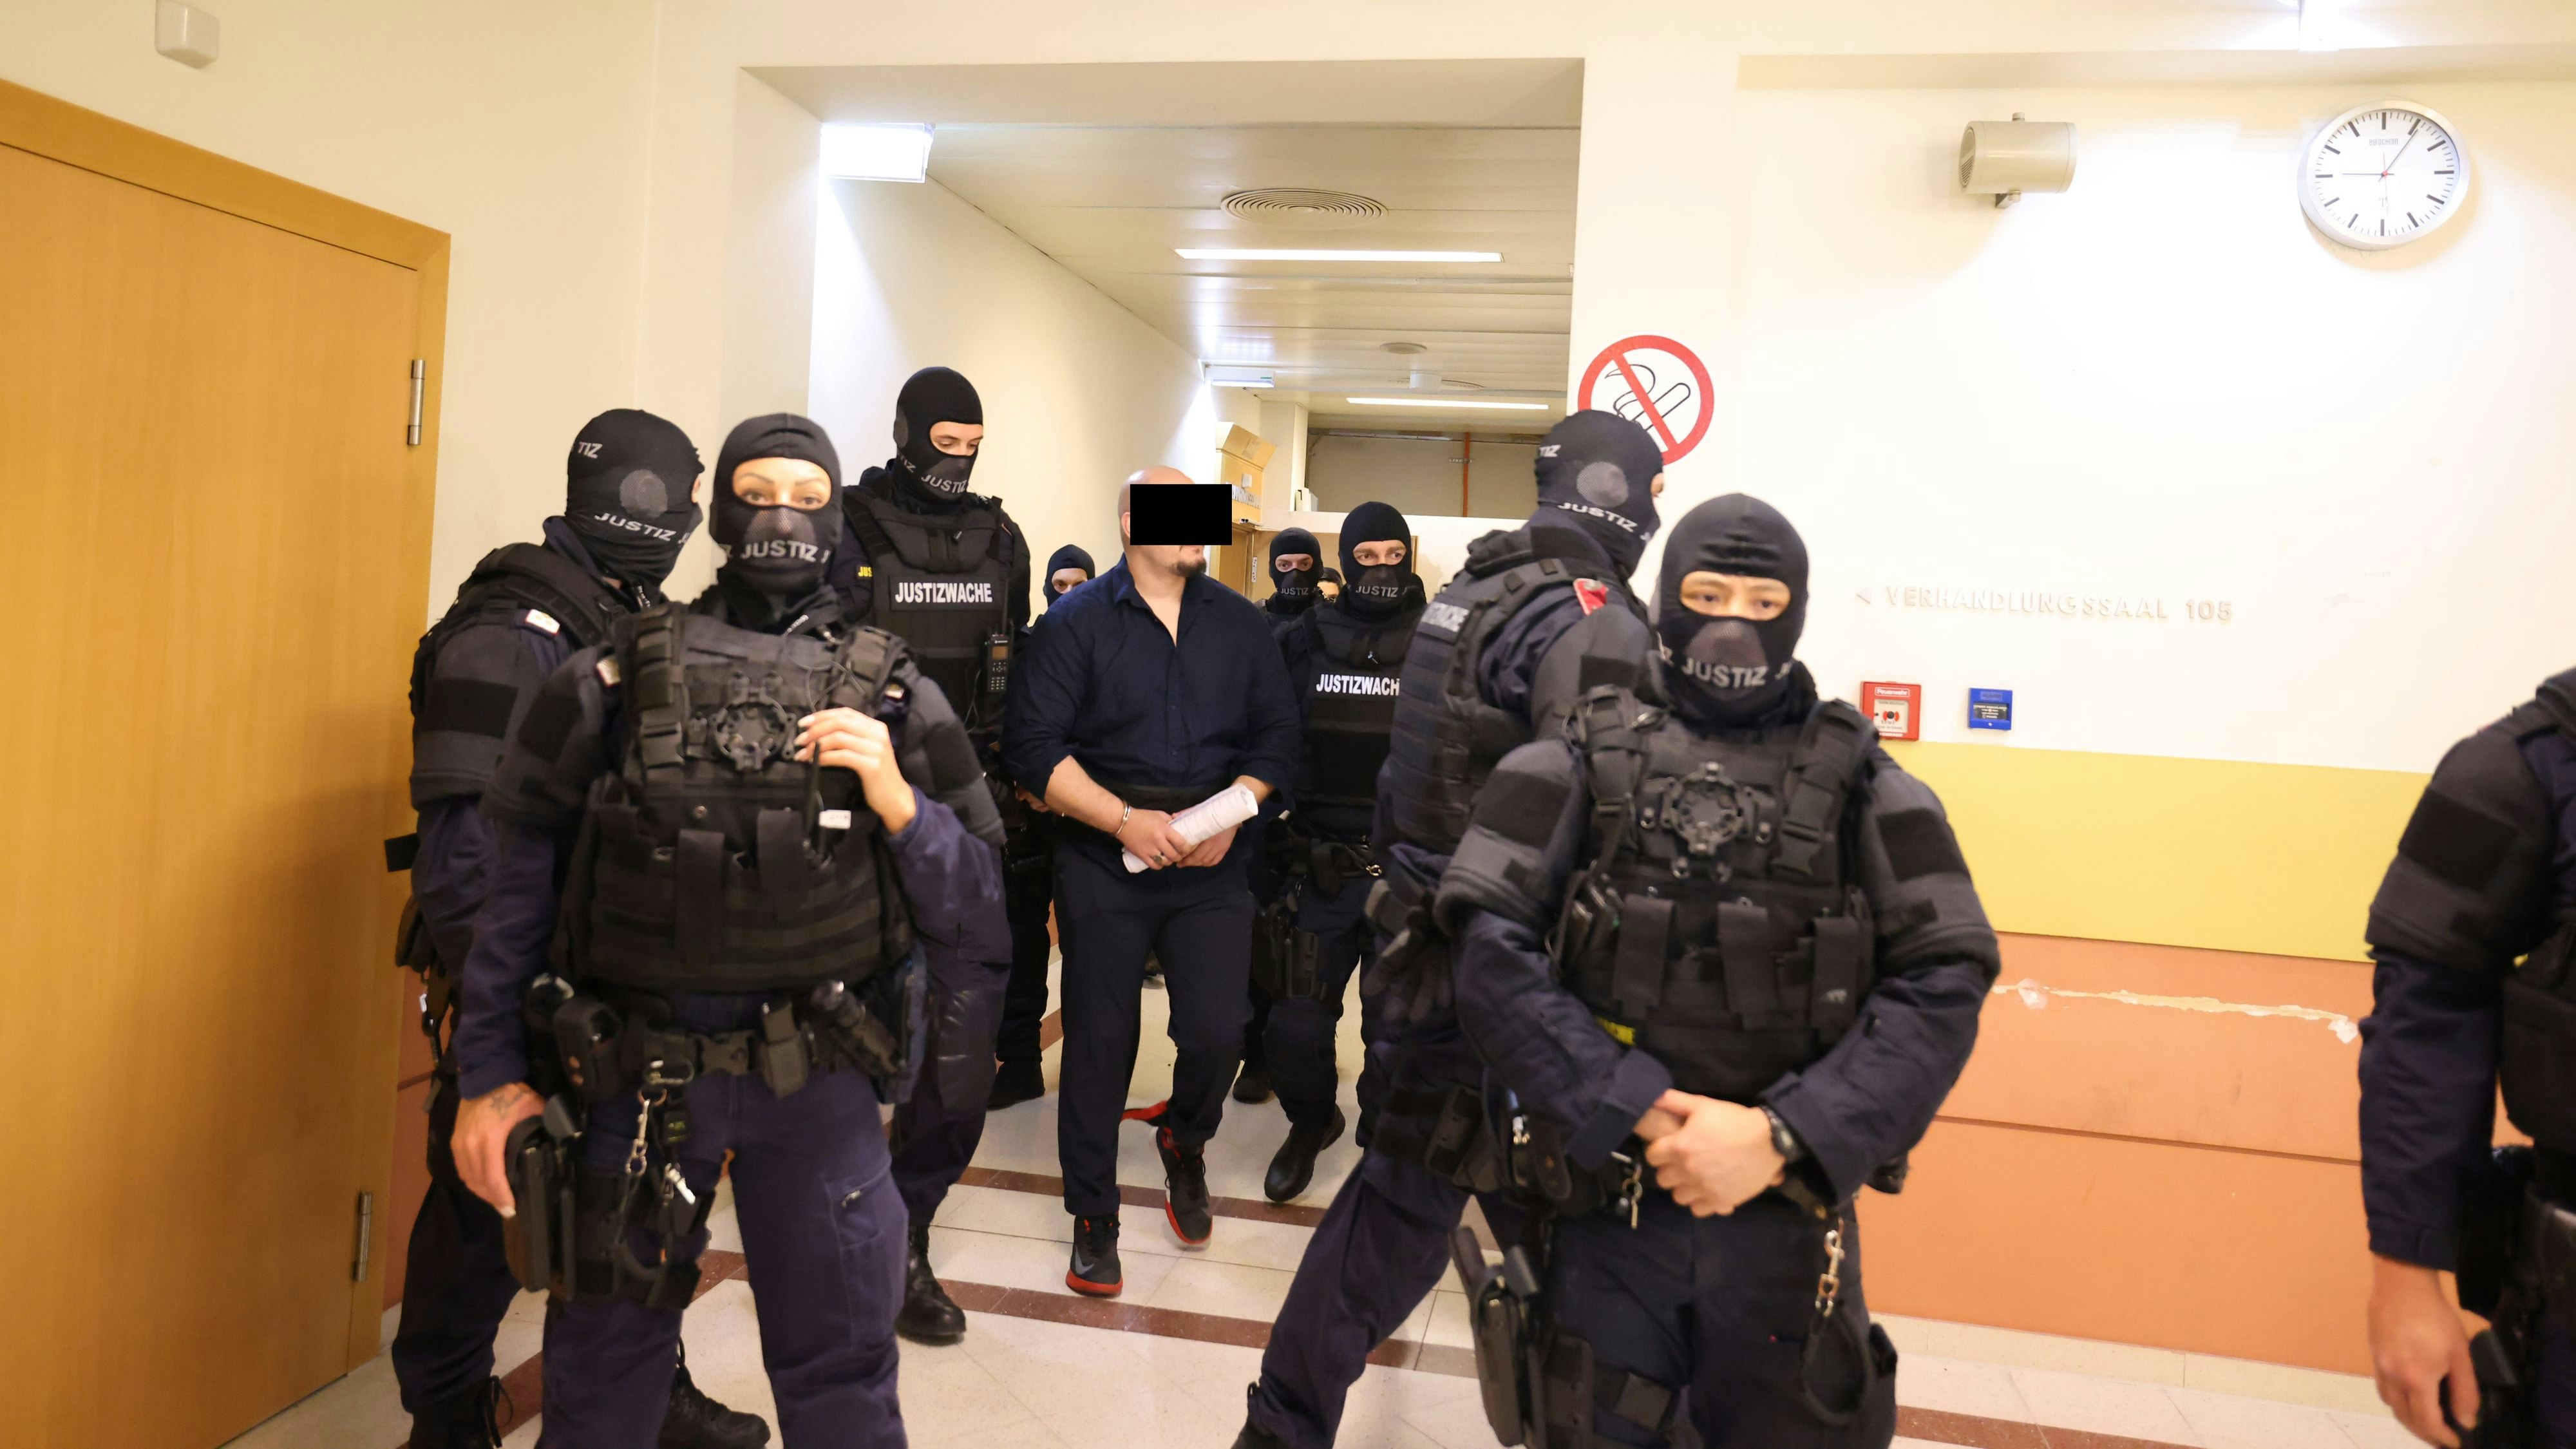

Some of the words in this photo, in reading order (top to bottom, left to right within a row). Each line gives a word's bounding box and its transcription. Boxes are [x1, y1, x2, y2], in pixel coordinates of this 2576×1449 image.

[578, 441, 603, 459] TIZ
[921, 475, 967, 493] JUSTIZ
[594, 513, 677, 542] JUSTIZ
[1557, 502, 1638, 533] JUSTIZ
[741, 539, 819, 563] JUSTIZ
[895, 582, 992, 603] JUSTIZWACHE
[1280, 587, 1309, 596] JUSTIZ
[1356, 585, 1399, 598] JUSTIZ
[1886, 585, 2168, 619] VERHANDLUNGSSAAL
[2185, 599, 2233, 621] 105
[1681, 658, 1768, 688] JUSTIZ
[1316, 674, 1400, 696] JUSTIZWACH
